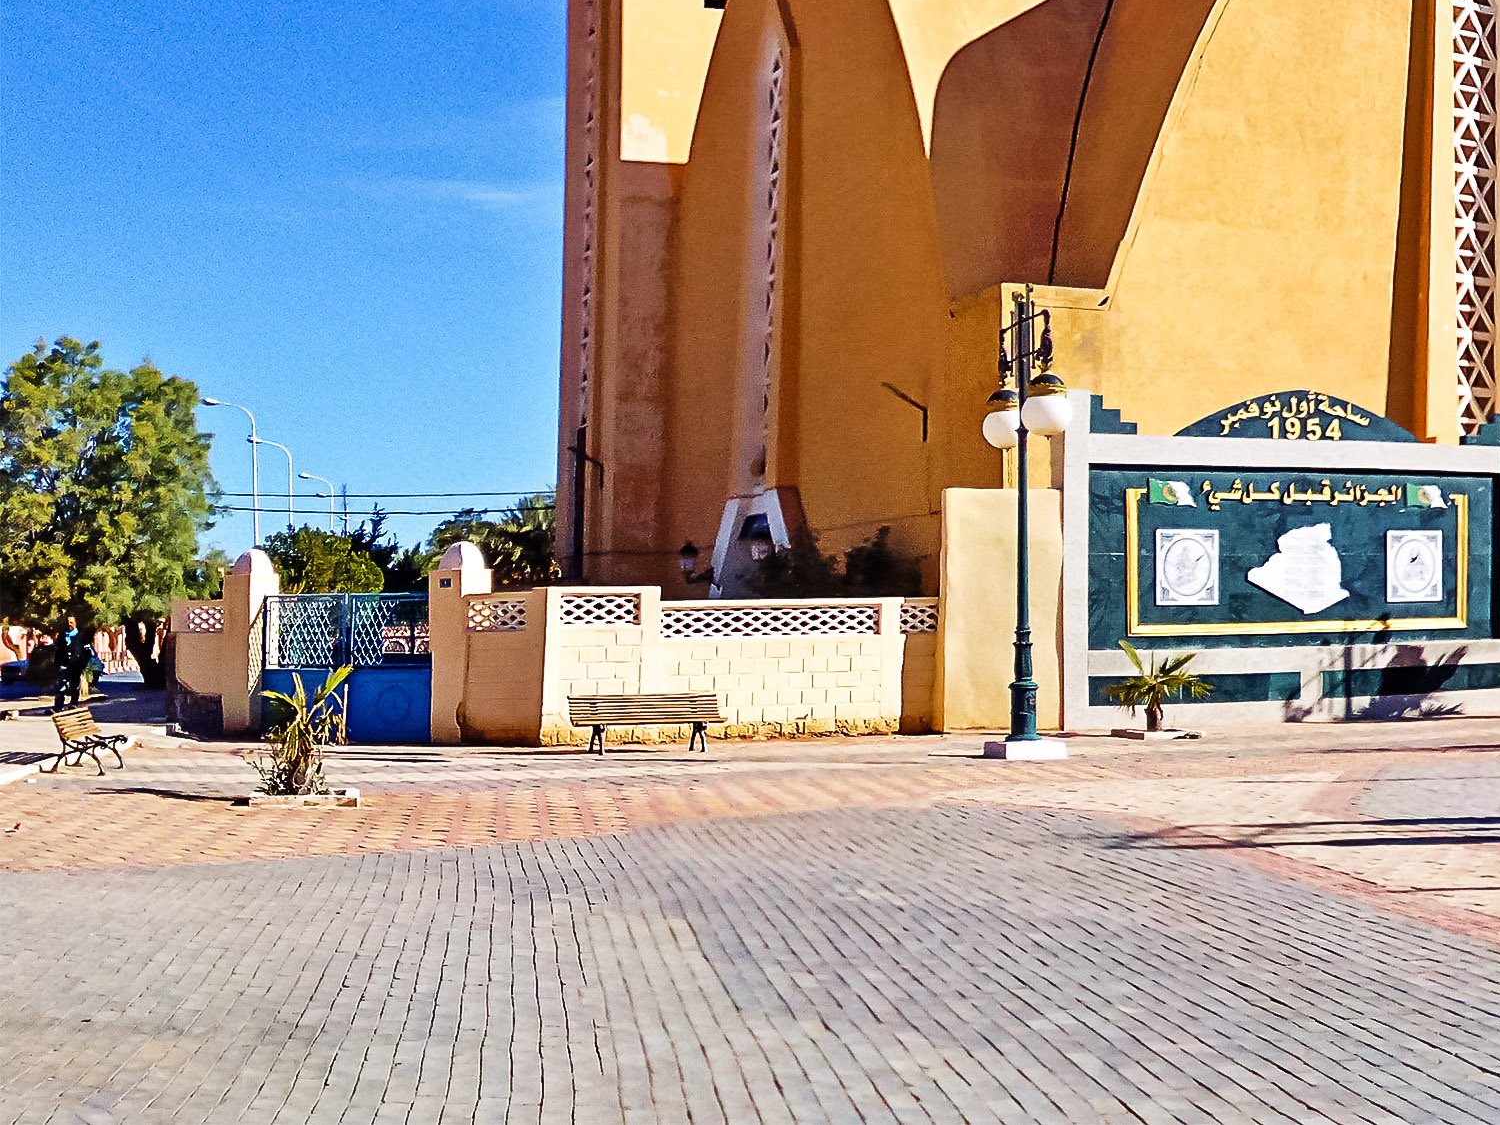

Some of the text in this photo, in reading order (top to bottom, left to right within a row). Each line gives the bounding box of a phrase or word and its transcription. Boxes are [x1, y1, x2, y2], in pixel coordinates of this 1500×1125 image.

[1219, 390, 1370, 436] ساحة أول نوفمبر
[1267, 416, 1342, 441] 1954
[1202, 478, 1402, 511] الجزائر قبل كل شيء
